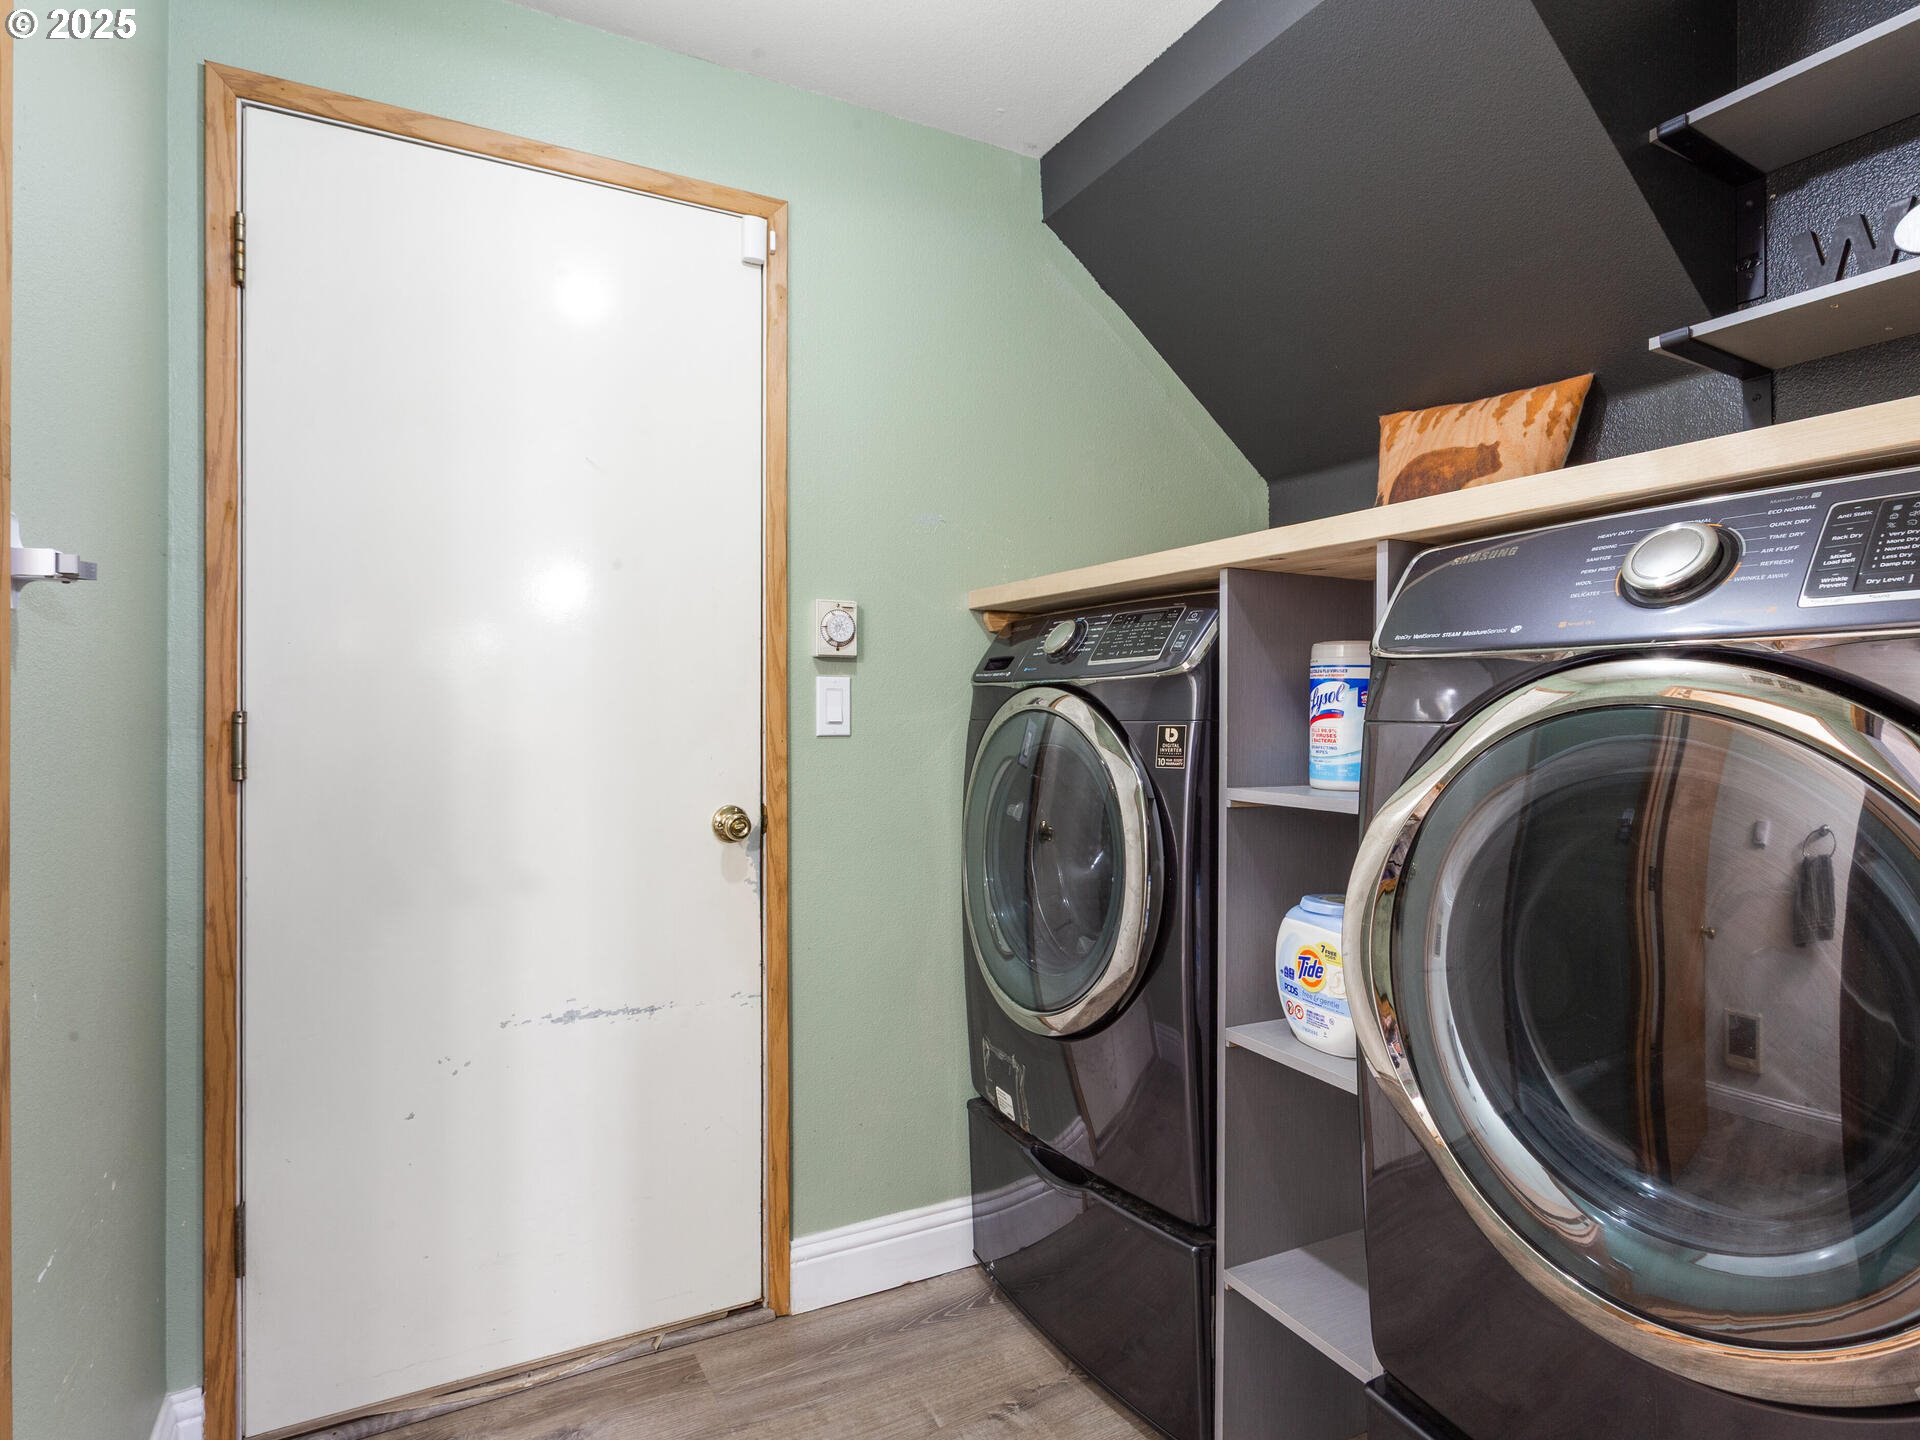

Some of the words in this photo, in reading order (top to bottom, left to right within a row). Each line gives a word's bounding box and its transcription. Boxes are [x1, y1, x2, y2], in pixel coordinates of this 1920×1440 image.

[1768, 508, 1782, 516] ECO
[1783, 504, 1817, 513] NORMAL
[1837, 512, 1853, 520] Anti
[1794, 518, 1811, 526] DRY
[1597, 532, 1618, 540] HEAVY
[1618, 529, 1636, 537] DUTY
[1769, 533, 1788, 541] TIME
[1831, 533, 1849, 541] Rack
[1849, 532, 1864, 540] Dry
[1889, 530, 1906, 538] Very
[1591, 543, 1618, 552] BEDDING
[1760, 547, 1775, 555] AIR
[1451, 546, 1519, 566] SAMSUNG
[1585, 555, 1613, 563] SANITIZE
[1829, 552, 1853, 560] Mixed
[1759, 559, 1794, 567] REFRESH
[1822, 558, 1841, 566] Load
[1580, 567, 1597, 575] PERM
[1766, 572, 1790, 580] AWAY
[1821, 575, 1849, 584] Wrinkle
[1866, 578, 1881, 586] Dry
[1882, 575, 1905, 583] Level
[1818, 582, 1848, 590] Prevent
[1321, 944, 1326, 953] 7
[1297, 955, 1324, 979] Tide
